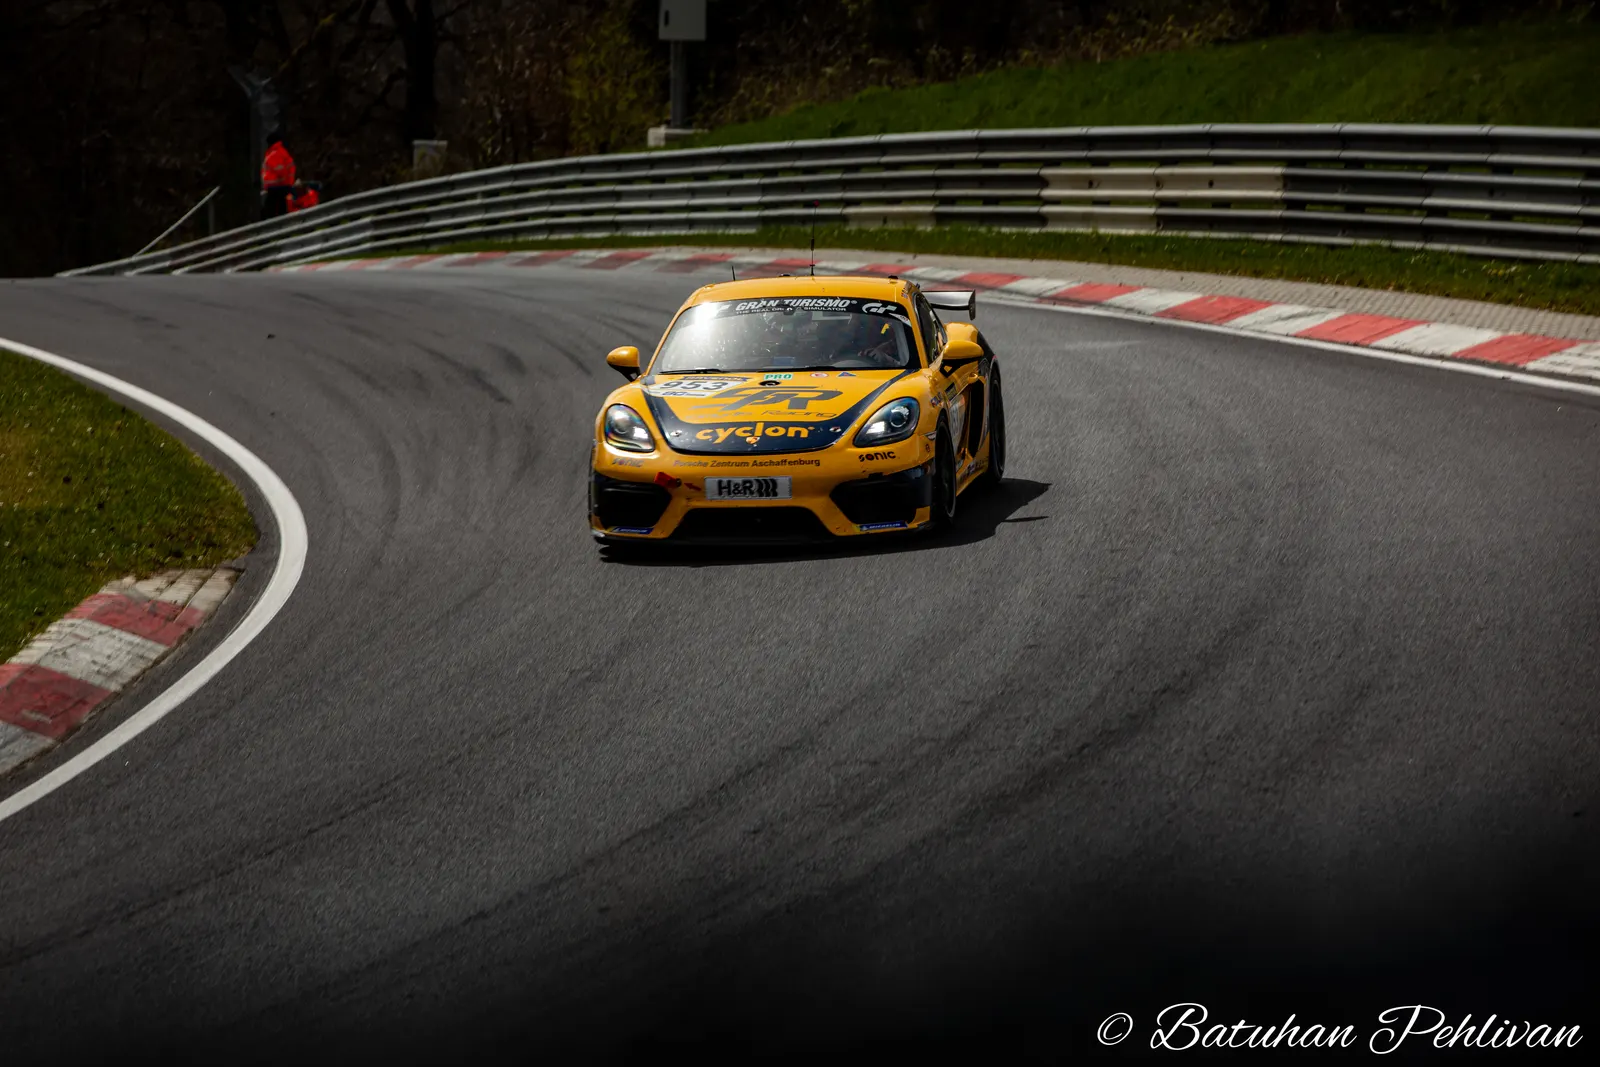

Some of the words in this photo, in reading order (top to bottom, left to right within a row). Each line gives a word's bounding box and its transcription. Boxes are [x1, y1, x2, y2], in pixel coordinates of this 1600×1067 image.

[736, 298, 779, 311] GRAN
[660, 381, 729, 391] 953
[695, 422, 809, 444] cyclon
[673, 460, 708, 468] Porsche
[710, 460, 750, 468] Zentrum
[751, 458, 821, 468] Aschaffenburg
